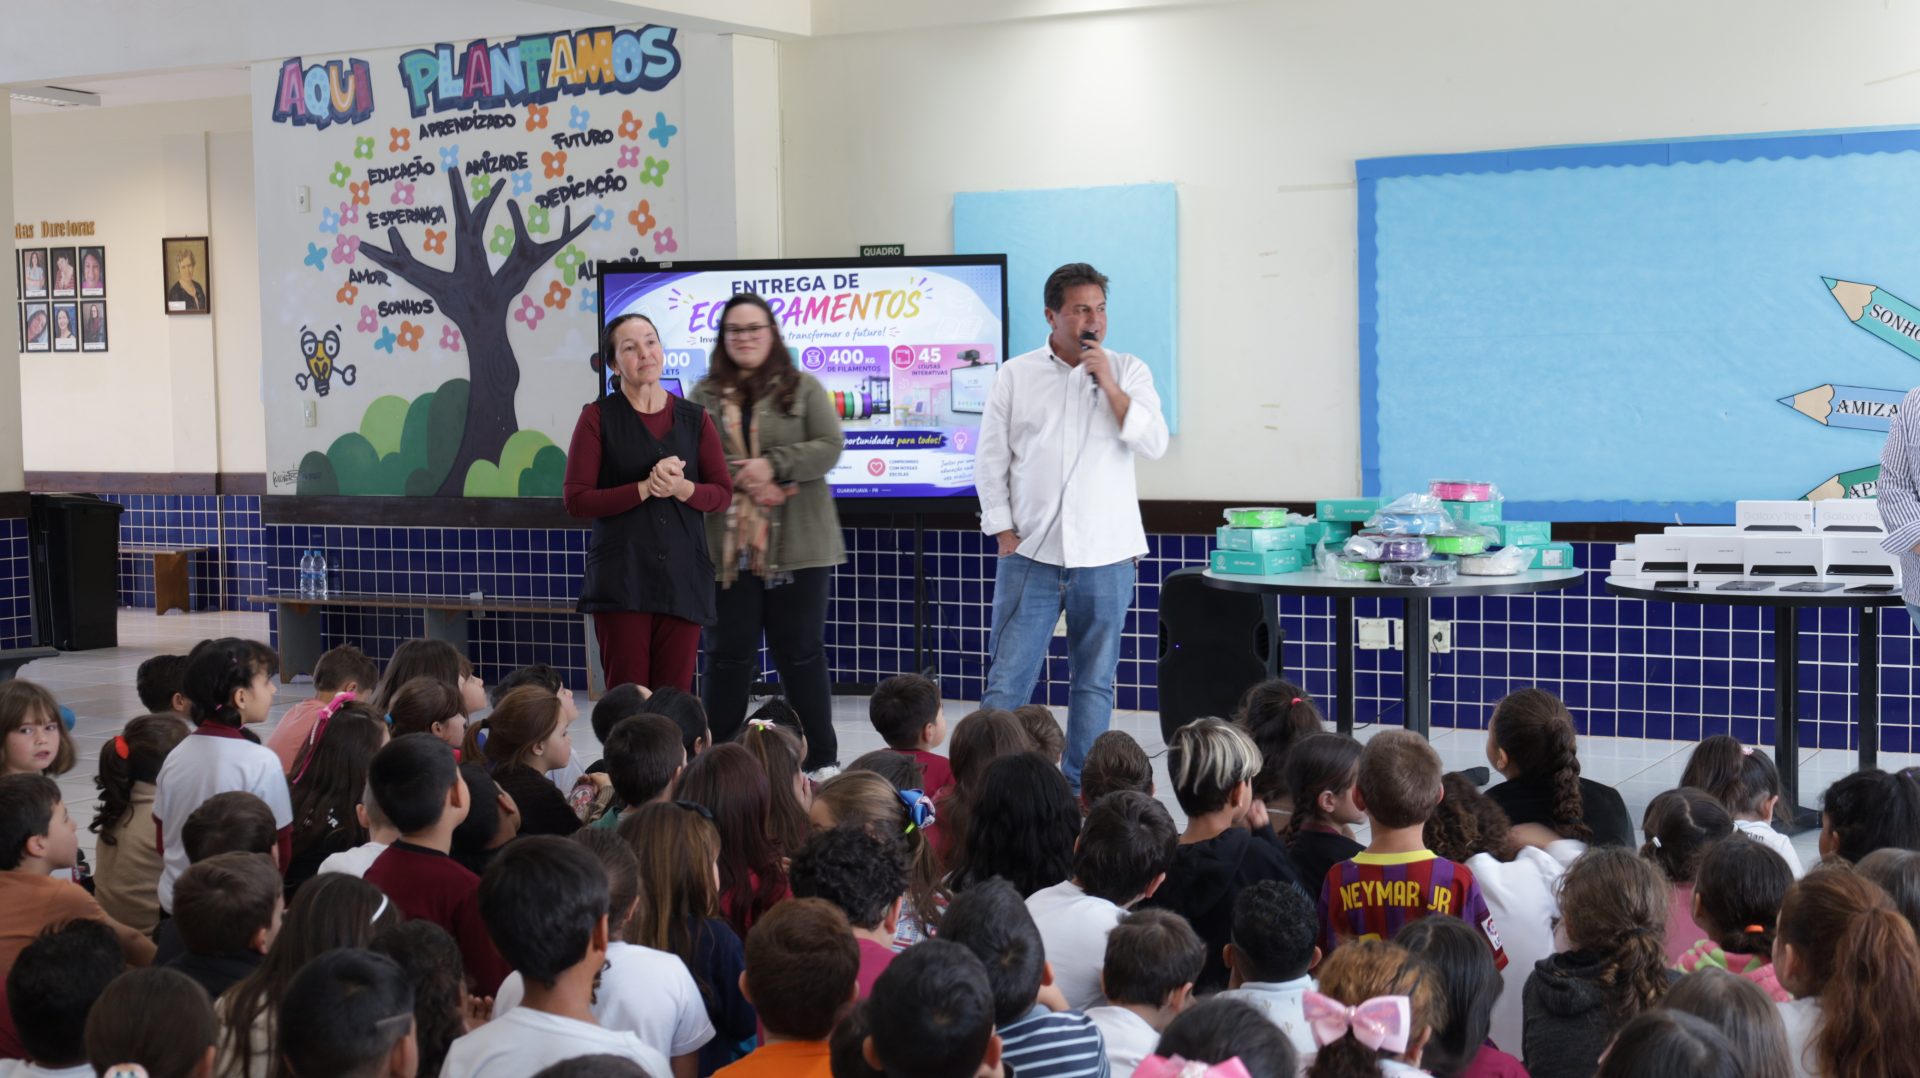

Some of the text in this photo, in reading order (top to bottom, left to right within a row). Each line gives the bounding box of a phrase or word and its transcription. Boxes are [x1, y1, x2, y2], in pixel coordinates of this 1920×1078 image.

[273, 25, 681, 129] AQUI PLANTAMOS
[552, 130, 614, 151] FUTURO
[367, 155, 436, 186] EDUCAÇÃO
[367, 206, 446, 230] ESPERANÇA
[41, 220, 95, 238] Diretoras
[863, 246, 901, 257] QUADRO
[348, 268, 392, 287] AMOR
[731, 273, 860, 297] ENTREGA DE
[378, 299, 434, 317] SONHOS
[788, 329, 842, 342] transformar
[852, 326, 887, 341] futuro!
[829, 349, 864, 365] 400
[919, 347, 941, 363] 45
[1836, 400, 1899, 417] AMIZA
[843, 432, 942, 449] portunidades para todos!
[1340, 881, 1452, 914] NEYMAR JR
